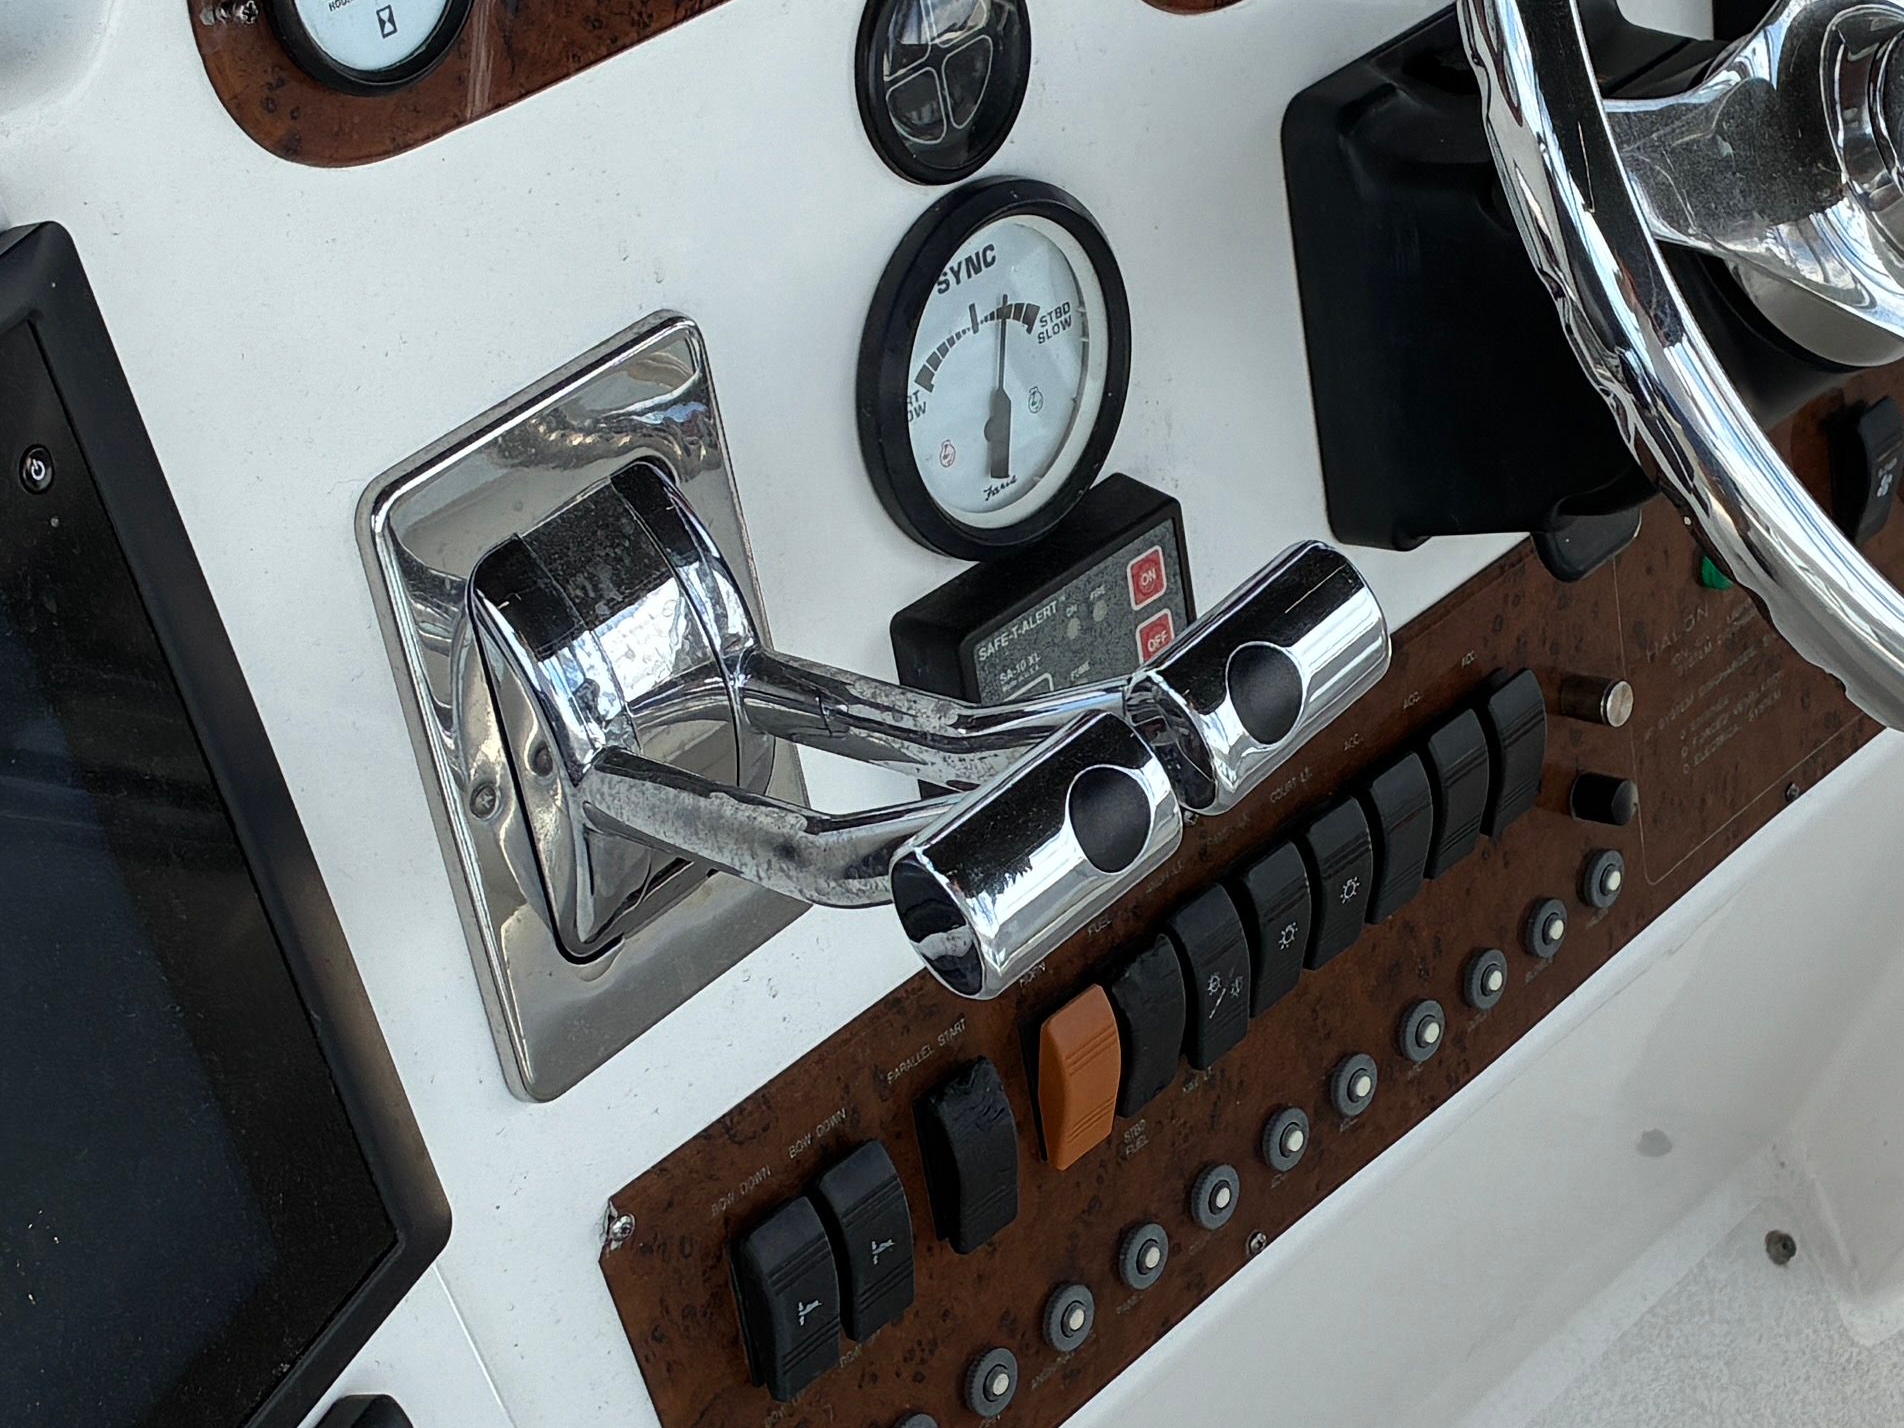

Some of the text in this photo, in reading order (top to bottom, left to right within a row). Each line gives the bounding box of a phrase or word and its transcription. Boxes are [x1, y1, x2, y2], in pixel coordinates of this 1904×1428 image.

[936, 243, 996, 295] SYNC
[1037, 315, 1072, 345] SLOW
[1038, 301, 1071, 329] STBD
[1140, 567, 1157, 586] ON
[977, 600, 1059, 662] SAFE-T-ALERT
[1147, 630, 1169, 653] OFF
[998, 661, 1027, 685] SA-10
[886, 1017, 967, 1085] PARALLEL START
[788, 1107, 847, 1160] BOW DOWN
